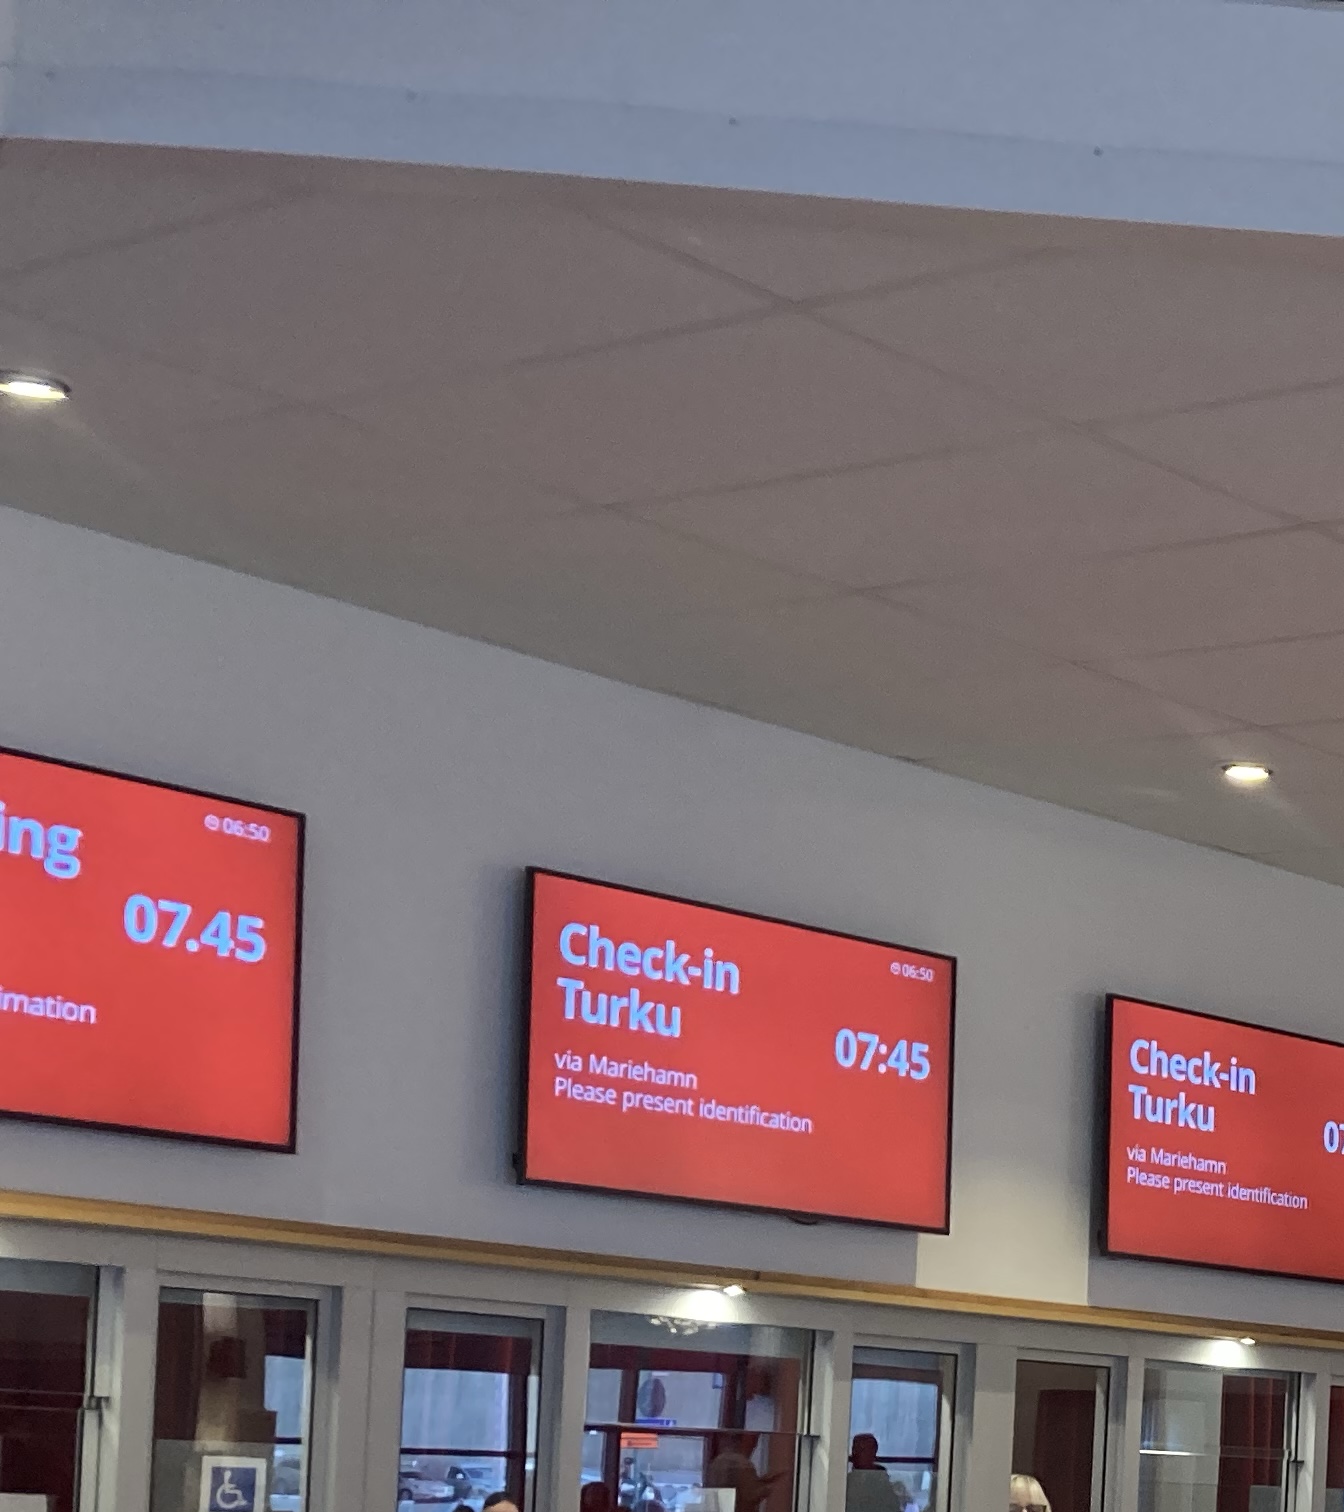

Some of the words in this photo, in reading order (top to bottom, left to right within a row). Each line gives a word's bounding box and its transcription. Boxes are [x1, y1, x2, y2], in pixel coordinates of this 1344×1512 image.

[222, 817, 271, 842] 06:50
[123, 894, 266, 963] 07.45
[559, 922, 740, 995] Check-in
[902, 964, 934, 982] 06:50
[556, 977, 681, 1038] Turku
[554, 1050, 582, 1072] via
[589, 1054, 698, 1090] Mariehamn
[834, 1028, 930, 1080] 07:45
[1129, 1039, 1255, 1094] Check-in
[554, 1077, 617, 1105] Please
[622, 1091, 694, 1116] present
[699, 1097, 812, 1134] identification
[1128, 1084, 1215, 1132] Turku
[1126, 1144, 1147, 1163] via
[1150, 1147, 1226, 1175] Mariehamn
[1126, 1166, 1171, 1189] Please
[1173, 1177, 1225, 1198] present
[1227, 1182, 1308, 1210] identification
